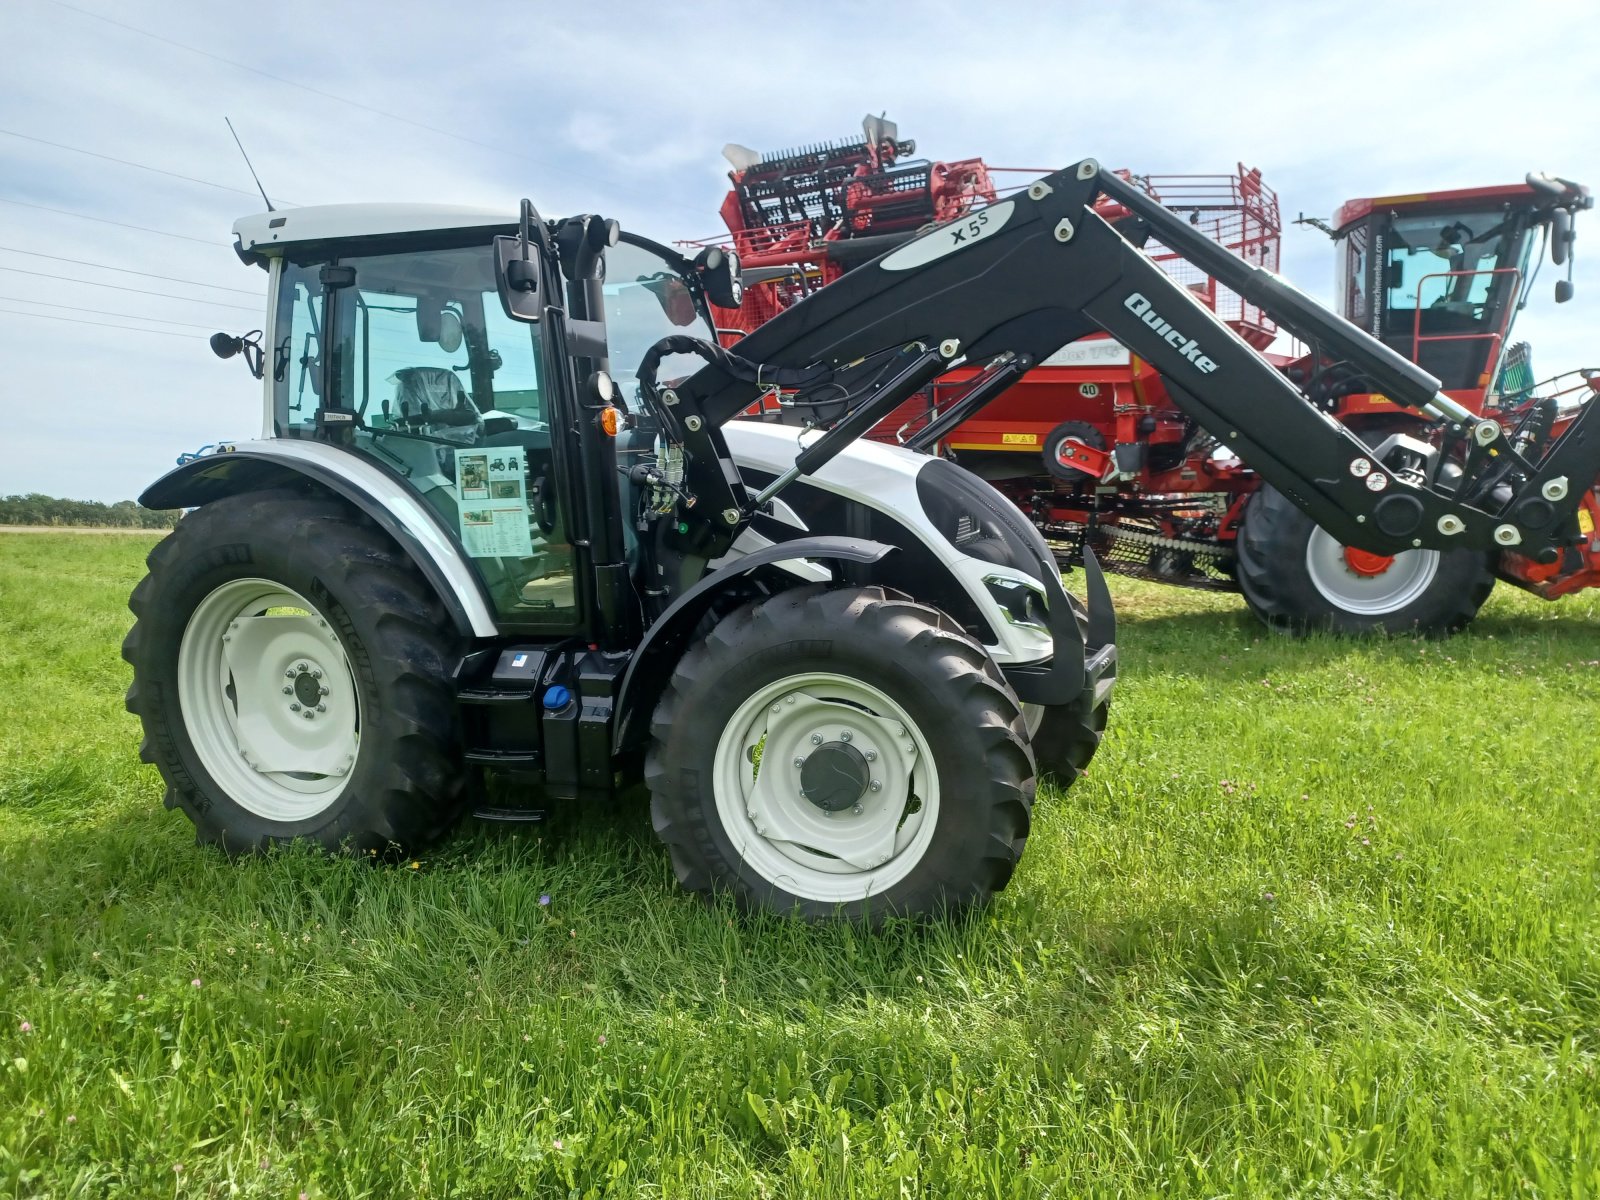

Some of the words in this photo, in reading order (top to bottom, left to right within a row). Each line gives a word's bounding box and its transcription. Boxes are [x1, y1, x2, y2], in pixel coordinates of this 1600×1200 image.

[1371, 234, 1383, 341] olmer-maschinenbau.com
[1123, 292, 1218, 374] Quicke
[1081, 384, 1096, 396] 40
